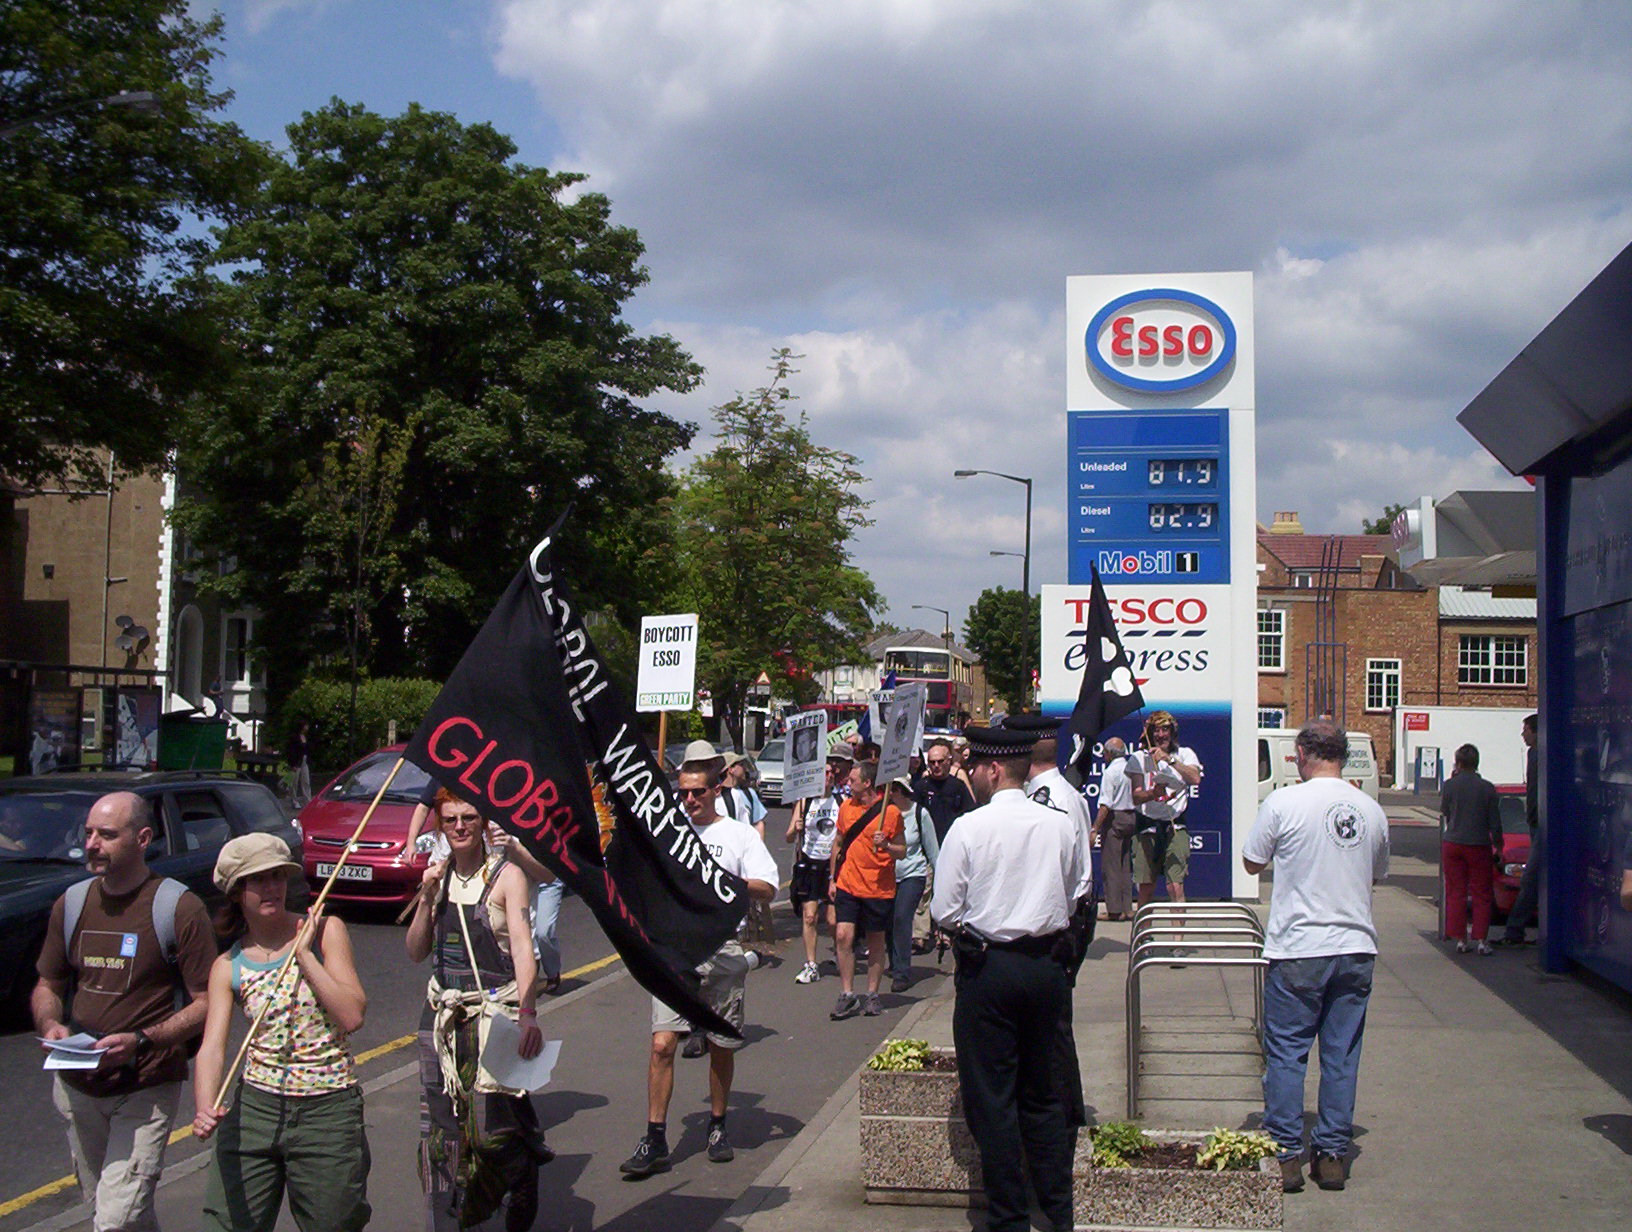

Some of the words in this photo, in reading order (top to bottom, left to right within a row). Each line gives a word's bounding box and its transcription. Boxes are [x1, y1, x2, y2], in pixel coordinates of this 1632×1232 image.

[1080, 462, 1127, 472] Unleaded
[1149, 461, 1210, 484] 81.9
[1081, 506, 1111, 516] Diesel
[1149, 504, 1212, 528] 82.9
[1099, 550, 1172, 574] Mobil
[644, 625, 693, 644] BOYCOTT
[653, 650, 681, 667] ESSO
[1064, 643, 1209, 672] eress
[428, 716, 581, 874] GLOBAL
[603, 723, 737, 904] WARMING
[320, 864, 346, 877] LB3
[347, 866, 368, 879] ZXC
